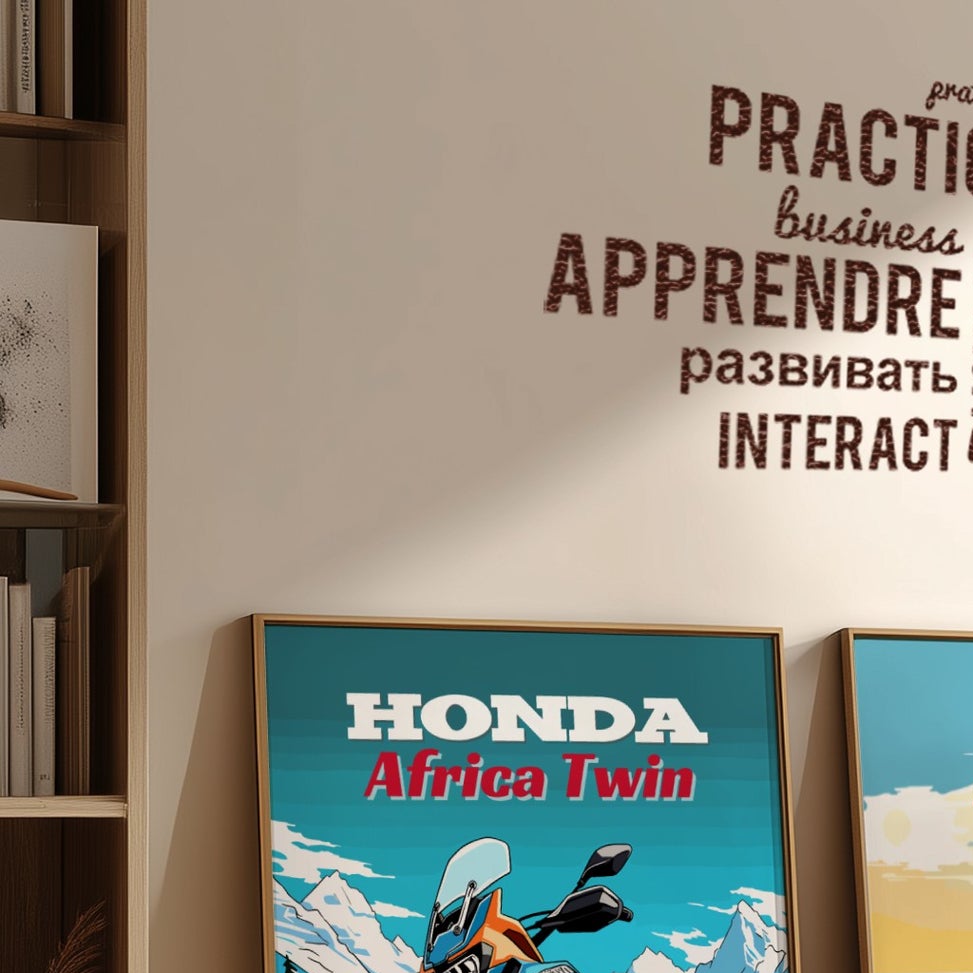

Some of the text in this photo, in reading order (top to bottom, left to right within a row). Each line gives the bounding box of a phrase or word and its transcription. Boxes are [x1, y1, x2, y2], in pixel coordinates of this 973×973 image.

[774, 185, 964, 256] business
[543, 232, 962, 339] APPRENDRE
[680, 346, 958, 394] развивать
[718, 411, 958, 471] INTERACT
[346, 692, 709, 743] HONDA
[364, 748, 697, 801] Africa Twin
